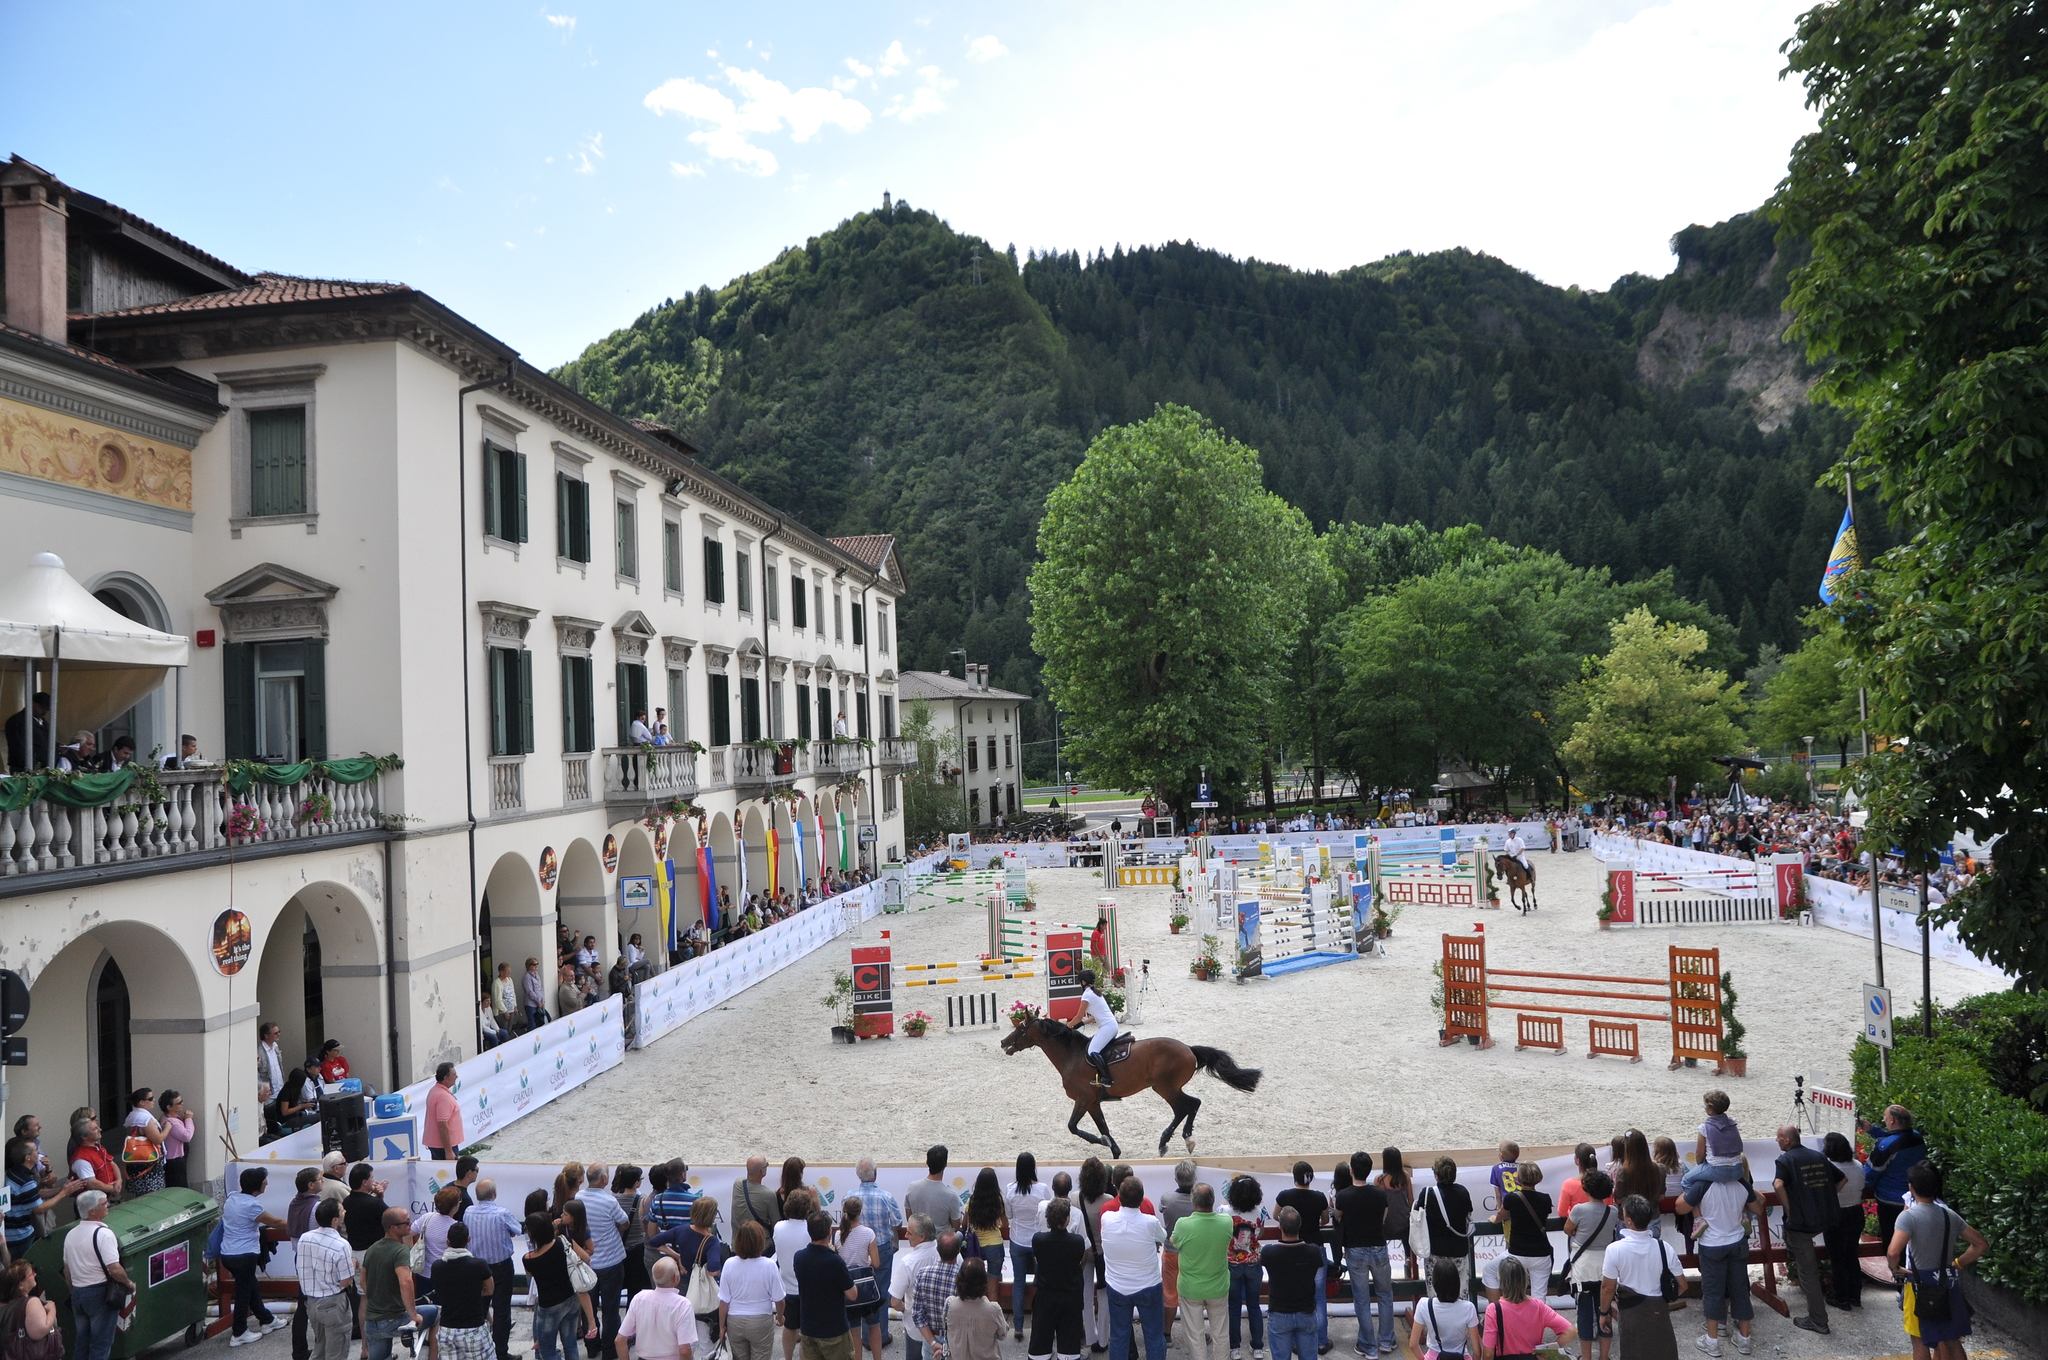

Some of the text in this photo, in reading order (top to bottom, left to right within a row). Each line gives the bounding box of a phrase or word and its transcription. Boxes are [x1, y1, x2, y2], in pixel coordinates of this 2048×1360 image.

[1200, 783, 1207, 794] P
[1890, 897, 1910, 909] roma
[1803, 913, 1810, 925] 7
[222, 955, 233, 966] real
[1050, 978, 1073, 986] BIKE
[855, 992, 880, 1001] BIKE
[1812, 1091, 1853, 1110] FINISH
[472, 1107, 494, 1126] CARNIA
